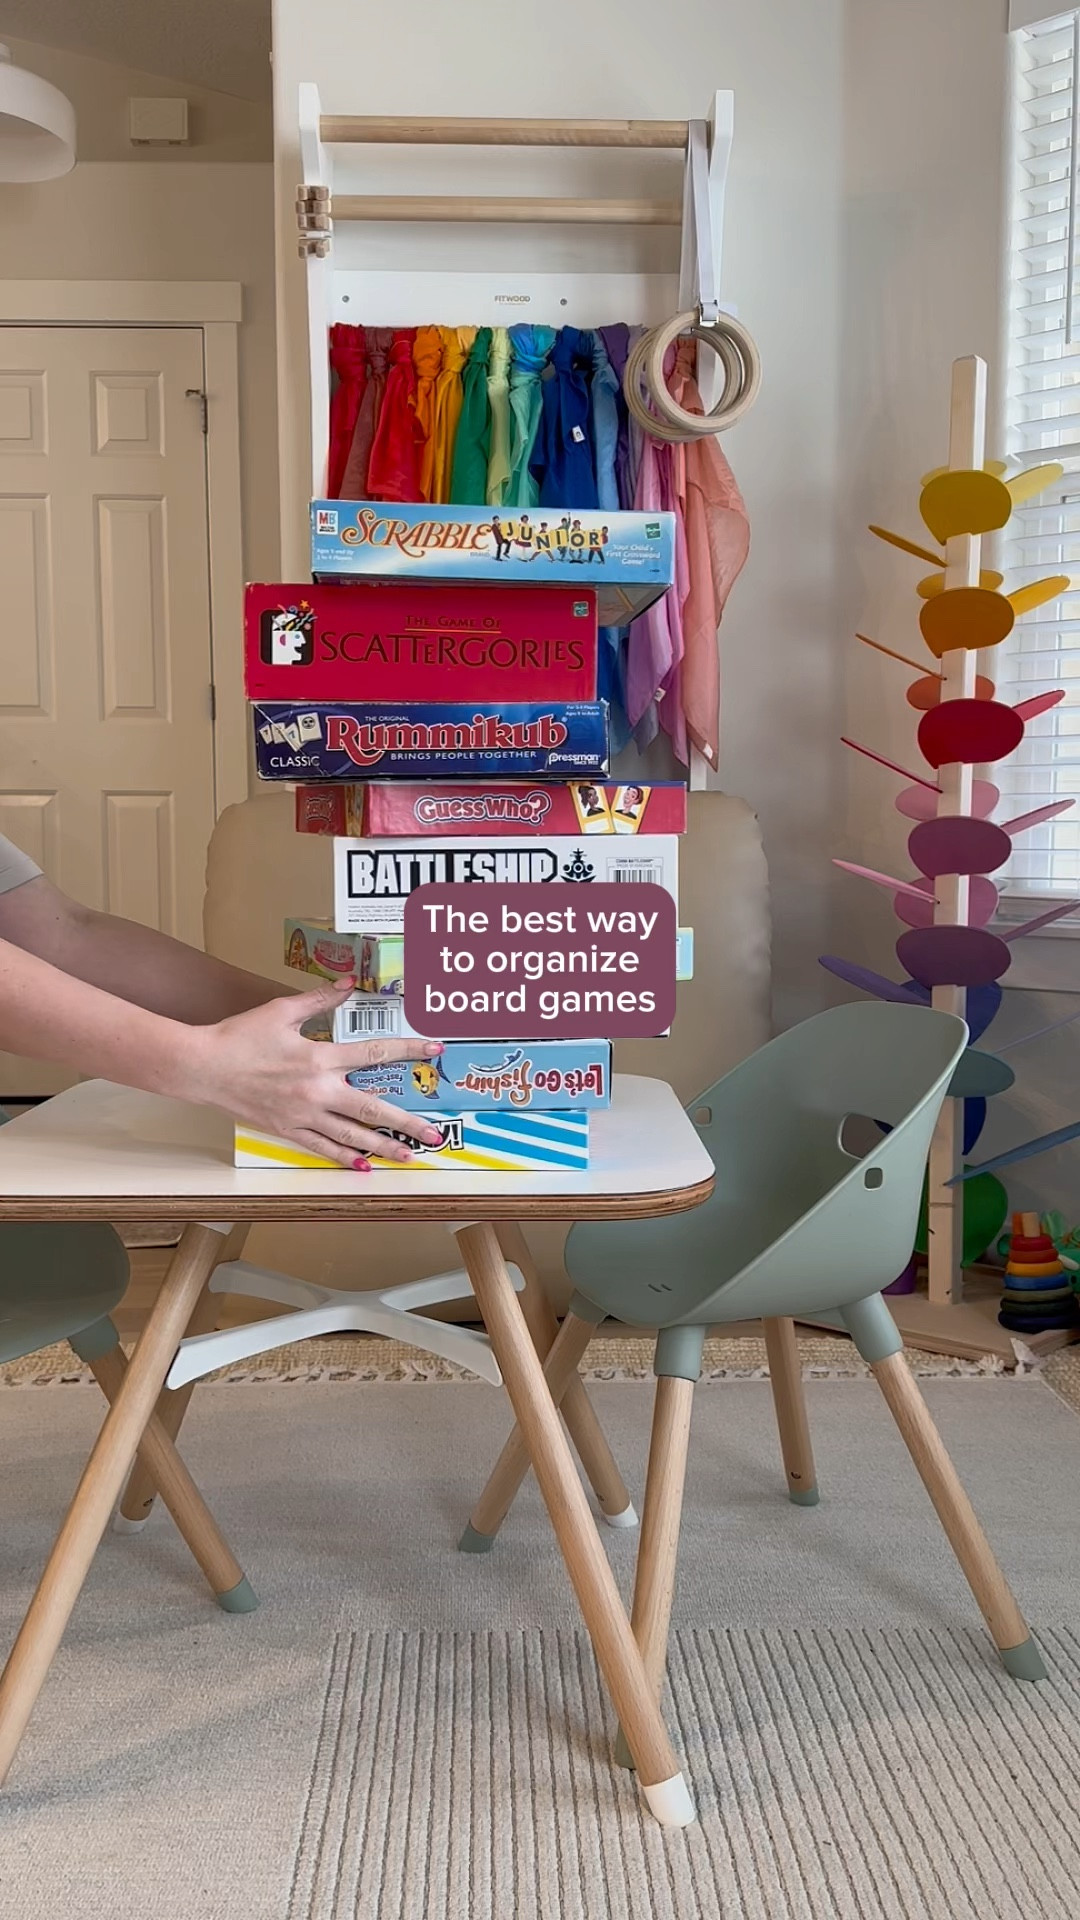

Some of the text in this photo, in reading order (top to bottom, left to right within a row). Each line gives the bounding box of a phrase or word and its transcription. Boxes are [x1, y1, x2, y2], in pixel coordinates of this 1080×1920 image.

[340, 507, 492, 559] SCRABBLE
[505, 521, 600, 551] JUNIOR
[320, 631, 585, 672] SCATTERGORIES
[325, 713, 568, 766] Rummikub
[270, 756, 320, 768] CLASSIC
[390, 750, 537, 761] BRINGS PEOPLE TOGETHER
[358, 1074, 403, 1084] fast-action
[388, 1086, 404, 1095] The
[534, 1069, 562, 1093] Go
[564, 1063, 604, 1097] Let's
